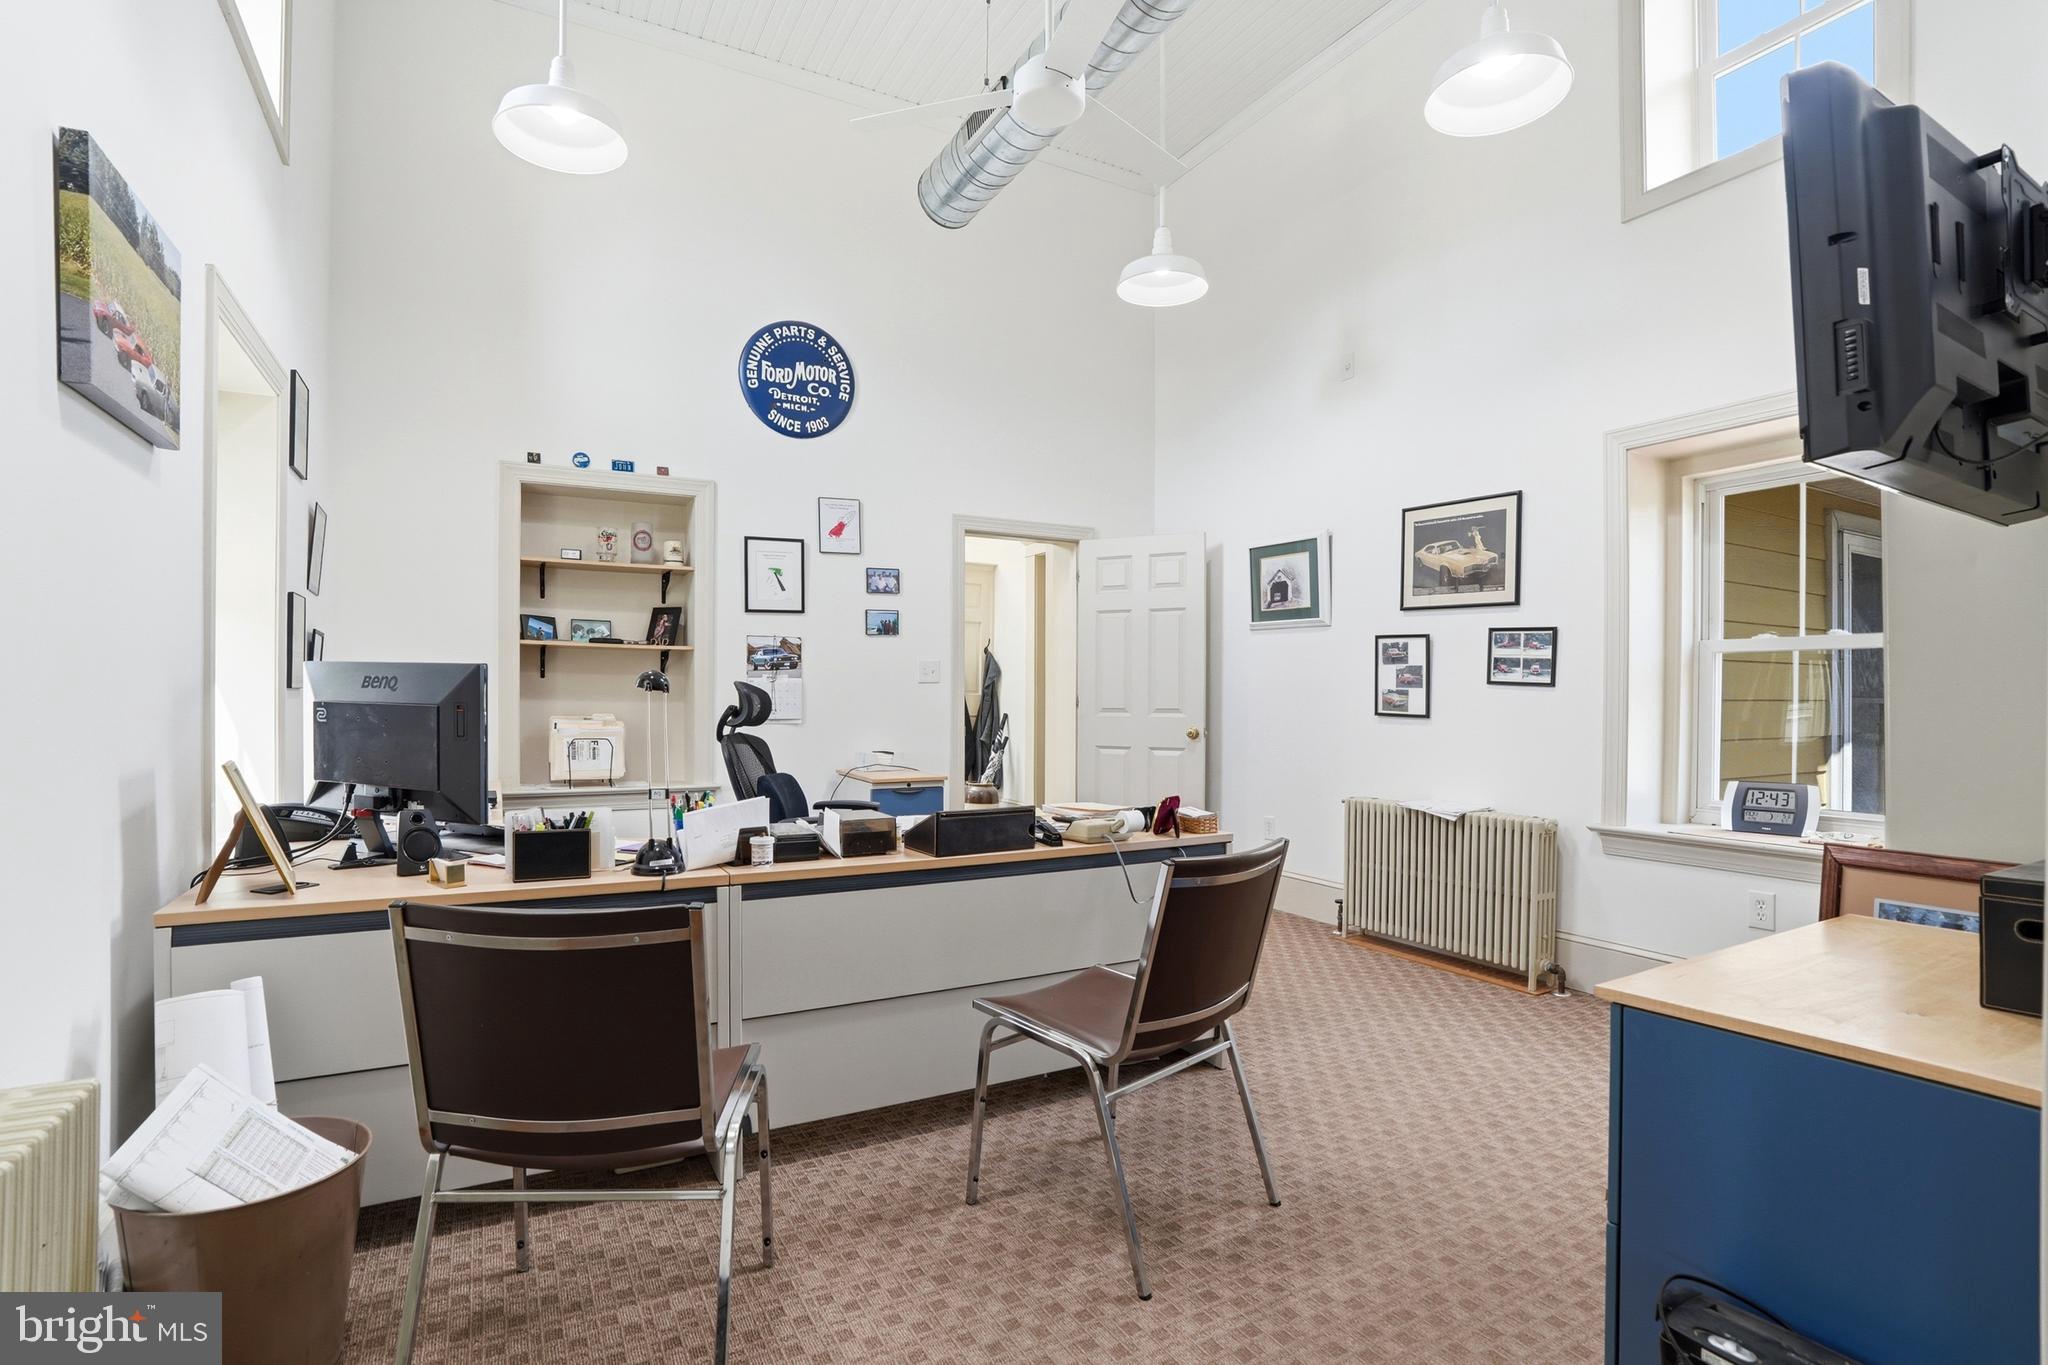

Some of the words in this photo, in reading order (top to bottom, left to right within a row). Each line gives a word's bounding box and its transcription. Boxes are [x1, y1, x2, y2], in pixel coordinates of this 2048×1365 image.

[747, 333, 774, 388] GENUINE
[773, 325, 816, 339] PARTS
[818, 336, 827, 347] &
[828, 345, 851, 402] SERVICE
[767, 409, 801, 433] SINCE
[805, 416, 830, 433] 1903
[1750, 791, 1790, 807] 12:43
